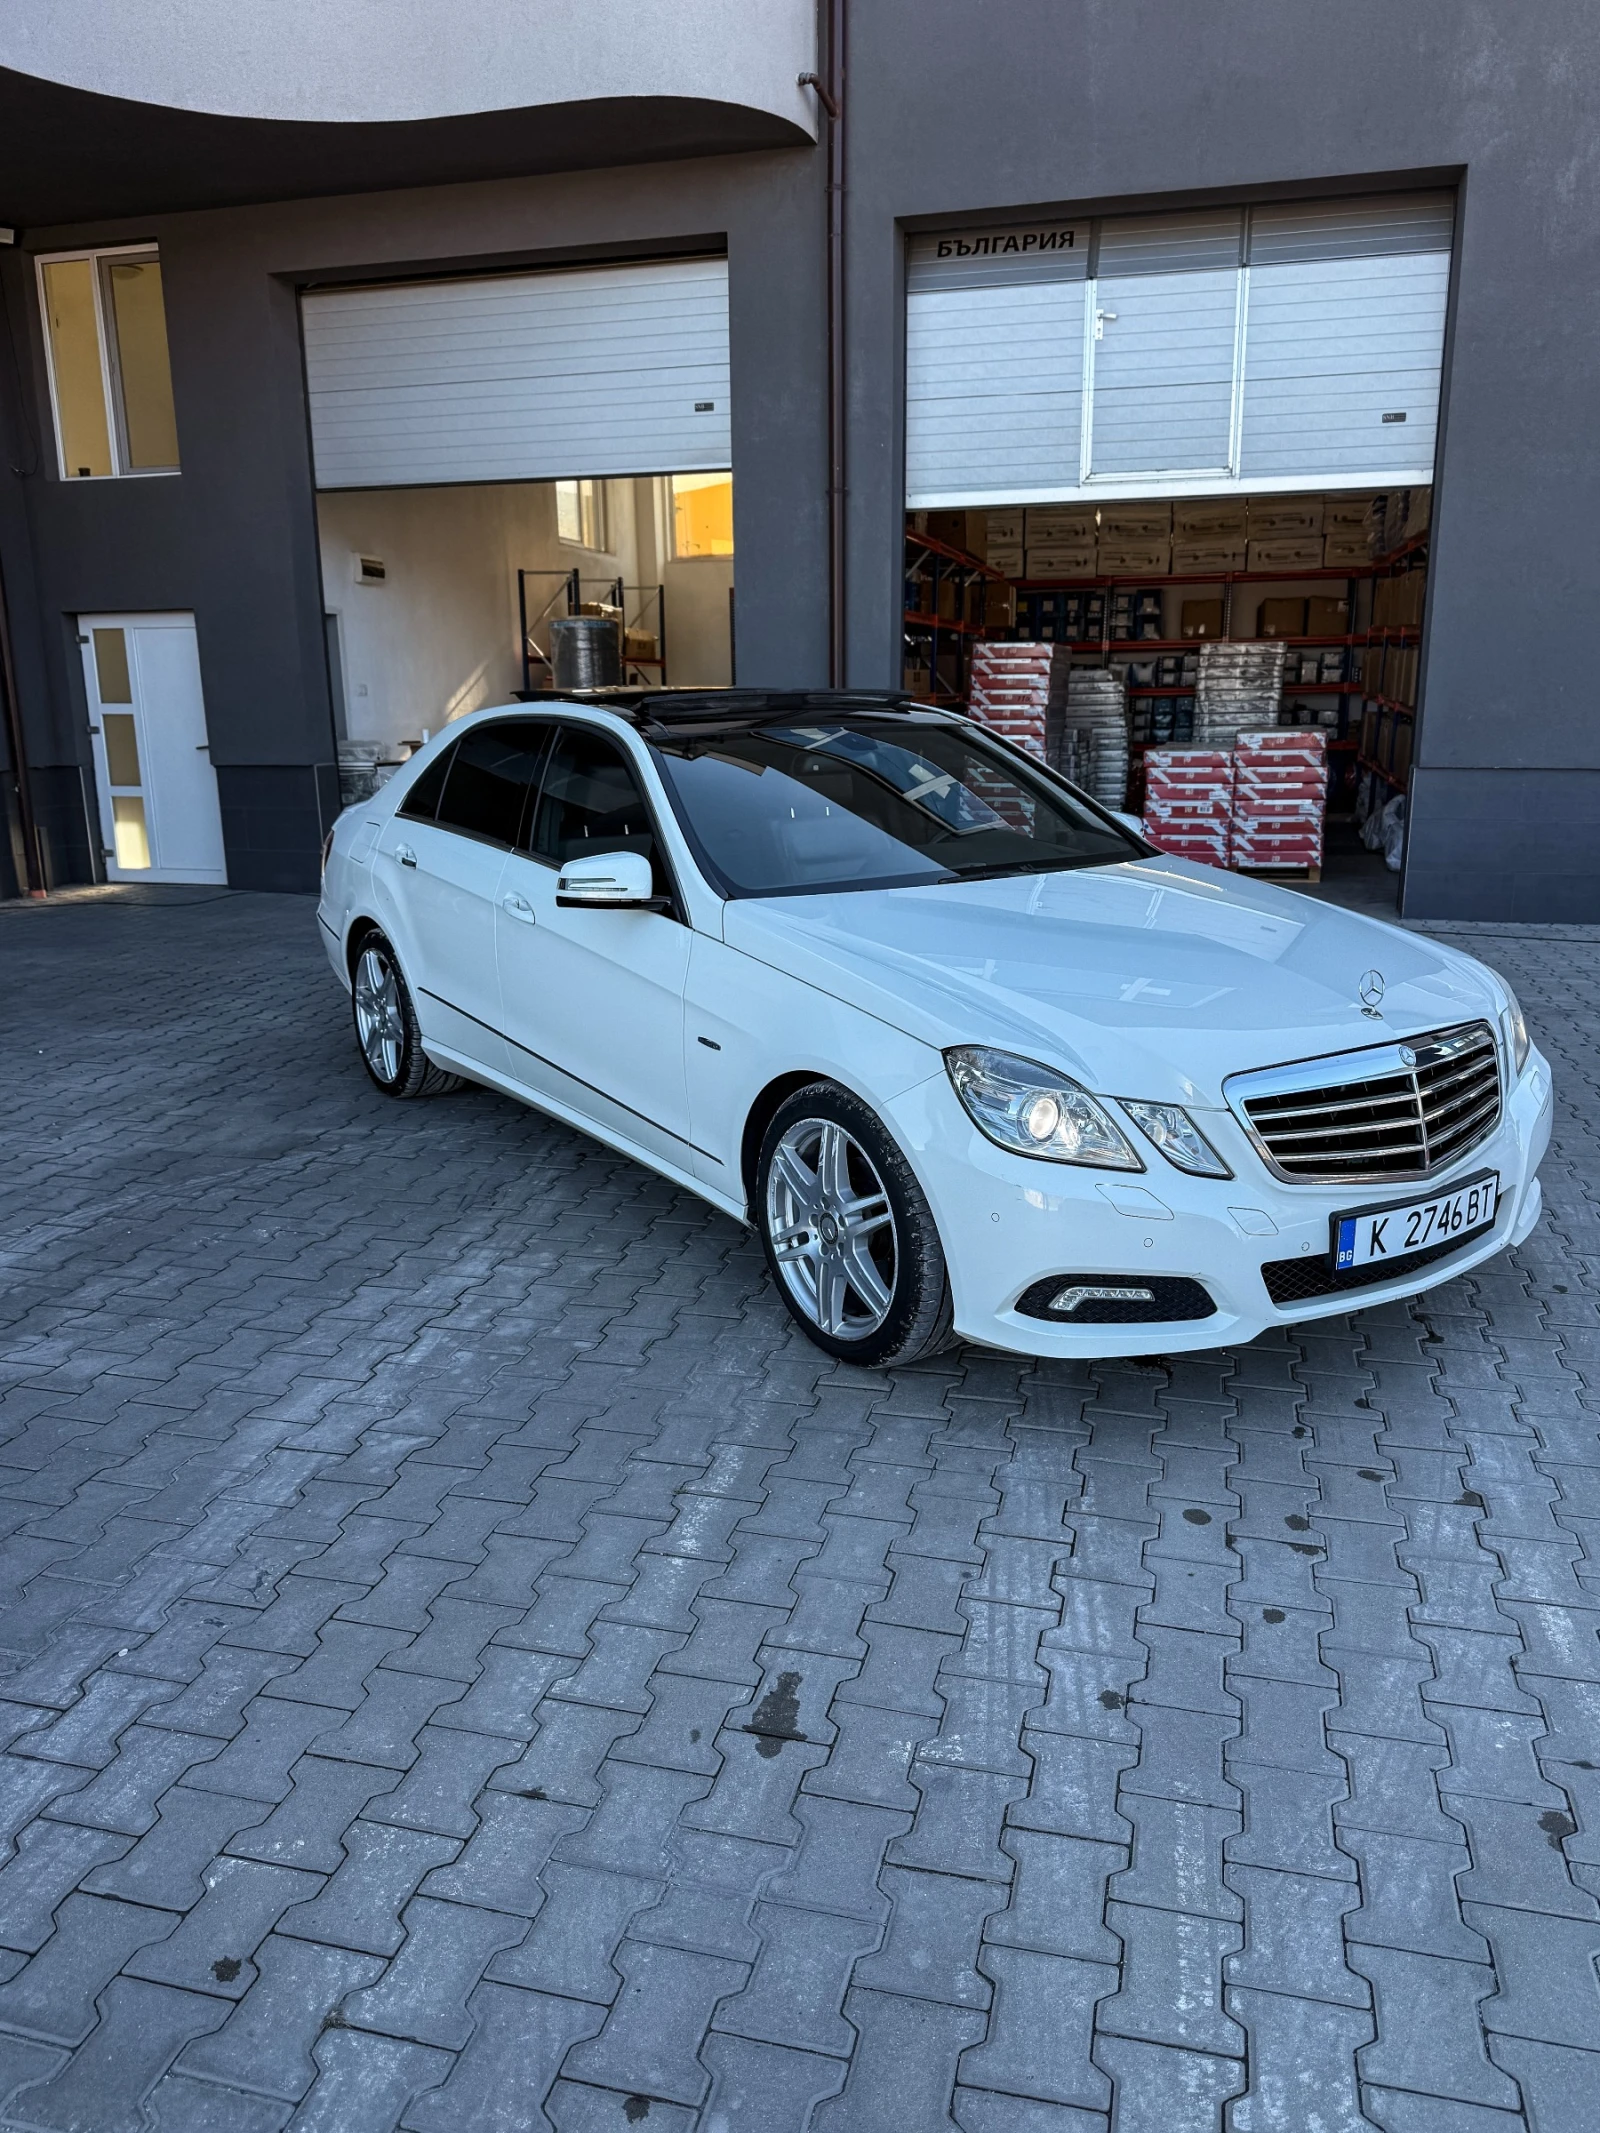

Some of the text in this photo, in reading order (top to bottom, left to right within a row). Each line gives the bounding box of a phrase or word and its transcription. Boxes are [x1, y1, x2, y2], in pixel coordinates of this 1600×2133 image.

[937, 231, 1075, 258] БЪЛГАРИЯ
[1369, 1217, 1389, 1257] K
[1404, 1196, 1463, 1248] 2746
[1338, 1249, 1353, 1263] BG
